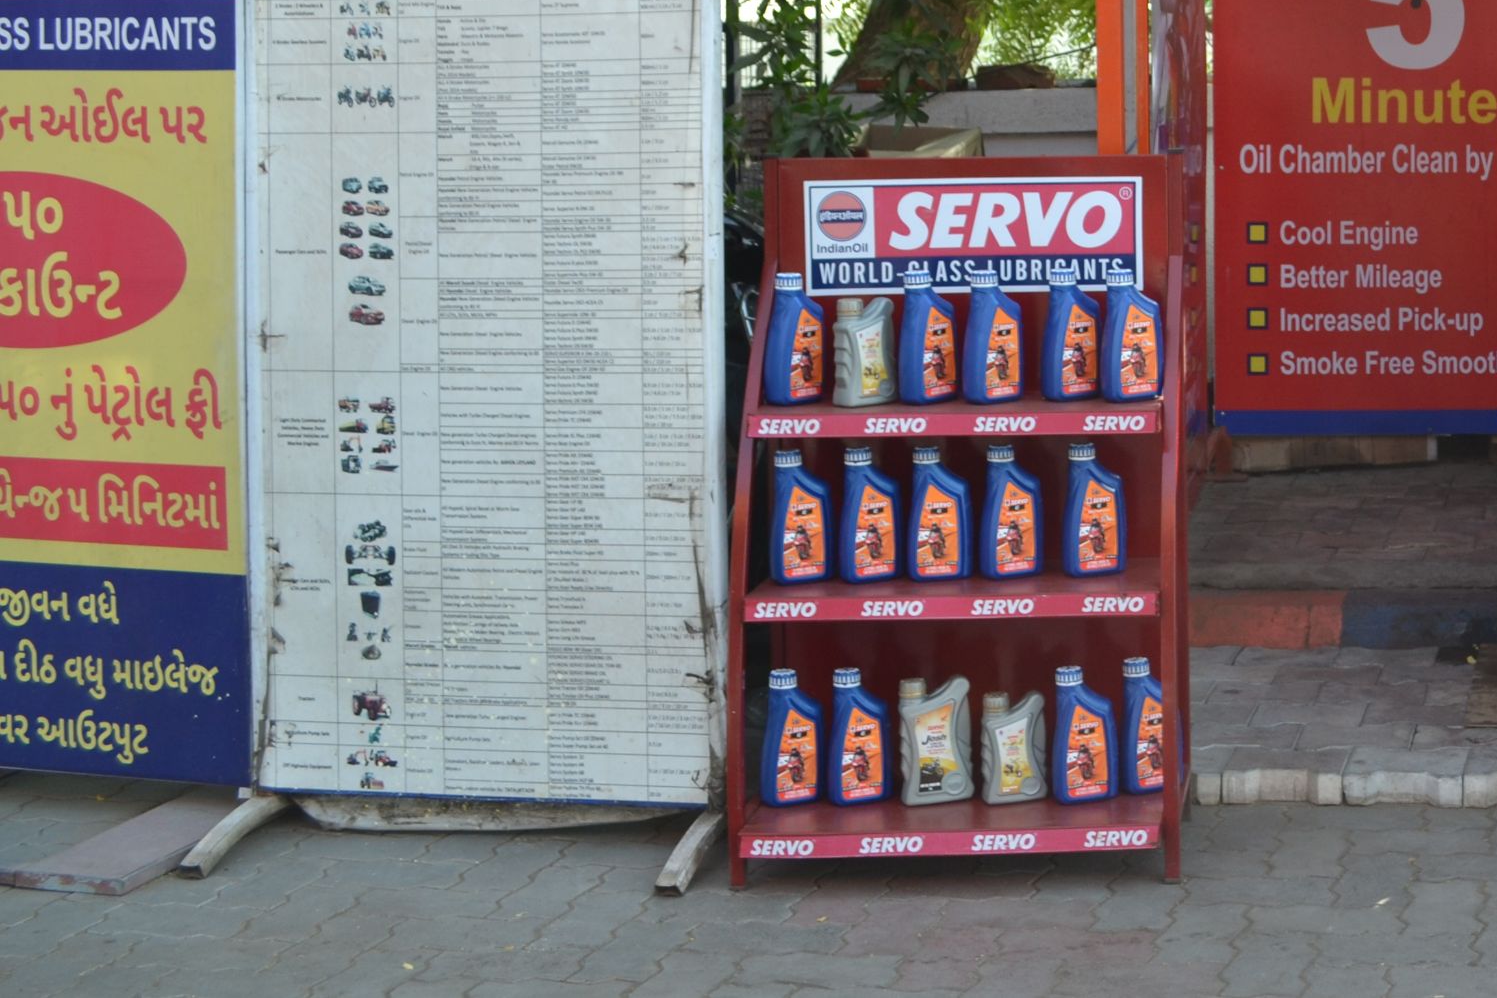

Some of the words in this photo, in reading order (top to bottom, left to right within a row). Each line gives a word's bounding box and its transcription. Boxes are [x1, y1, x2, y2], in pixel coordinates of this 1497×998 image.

[38, 16, 217, 51] LUBRICANTS
[159, 105, 208, 144] પર
[1239, 144, 1271, 174] Oil
[1278, 144, 1385, 174] Chamber
[1392, 144, 1461, 174] Clean
[1466, 144, 1494, 180] by
[889, 190, 1123, 251] SERVO
[1279, 220, 1332, 245] Cool
[1339, 220, 1419, 250] Engine
[816, 242, 869, 254] IndianOil
[1279, 264, 1349, 288] Better
[1355, 264, 1443, 294] Mileage
[1280, 307, 1390, 331] Increased
[1398, 307, 1484, 337] Pick-up
[1280, 350, 1358, 376] Smoke
[1365, 350, 1415, 375] Free
[757, 417, 821, 435] SERVO
[864, 416, 927, 434] SERVO
[973, 415, 1036, 433] SERVO
[1083, 414, 1146, 432] SERVO
[753, 601, 817, 619] SERVO
[861, 600, 924, 617] SERVO
[970, 598, 1035, 616] SERVO
[1081, 596, 1145, 614] SERVO
[859, 836, 924, 853] SERVO
[971, 833, 1036, 851] SERVO
[1084, 829, 1149, 847] SERVO
[750, 839, 815, 856] SERVO
